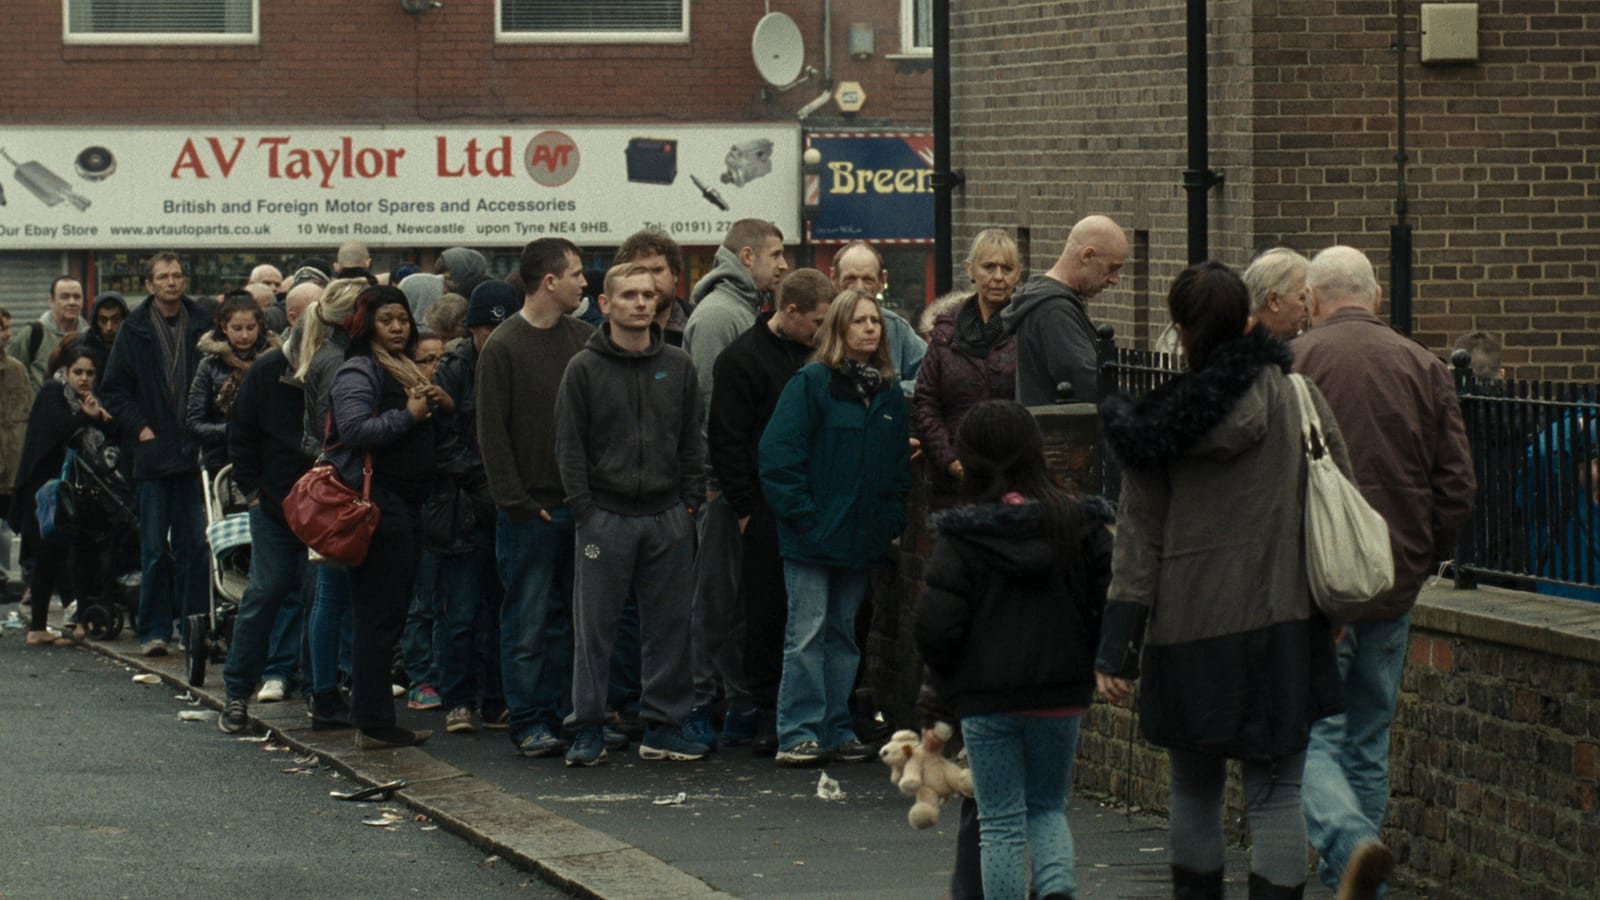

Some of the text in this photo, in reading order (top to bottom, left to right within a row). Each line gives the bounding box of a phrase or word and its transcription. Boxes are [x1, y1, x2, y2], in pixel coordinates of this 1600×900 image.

[170, 135, 515, 189] AV Taylor Ltd
[531, 144, 575, 173] AVT
[163, 198, 577, 217] British and Foreign Motor Spares and Accessories
[24, 224, 58, 239] Ebay
[62, 224, 98, 236] Store
[110, 223, 271, 238] www.avtautoparts.co.uk
[297, 221, 612, 236] 10 West Road, Newcastle upon Tyne NE4 9HB.
[671, 221, 711, 234] (0191)
